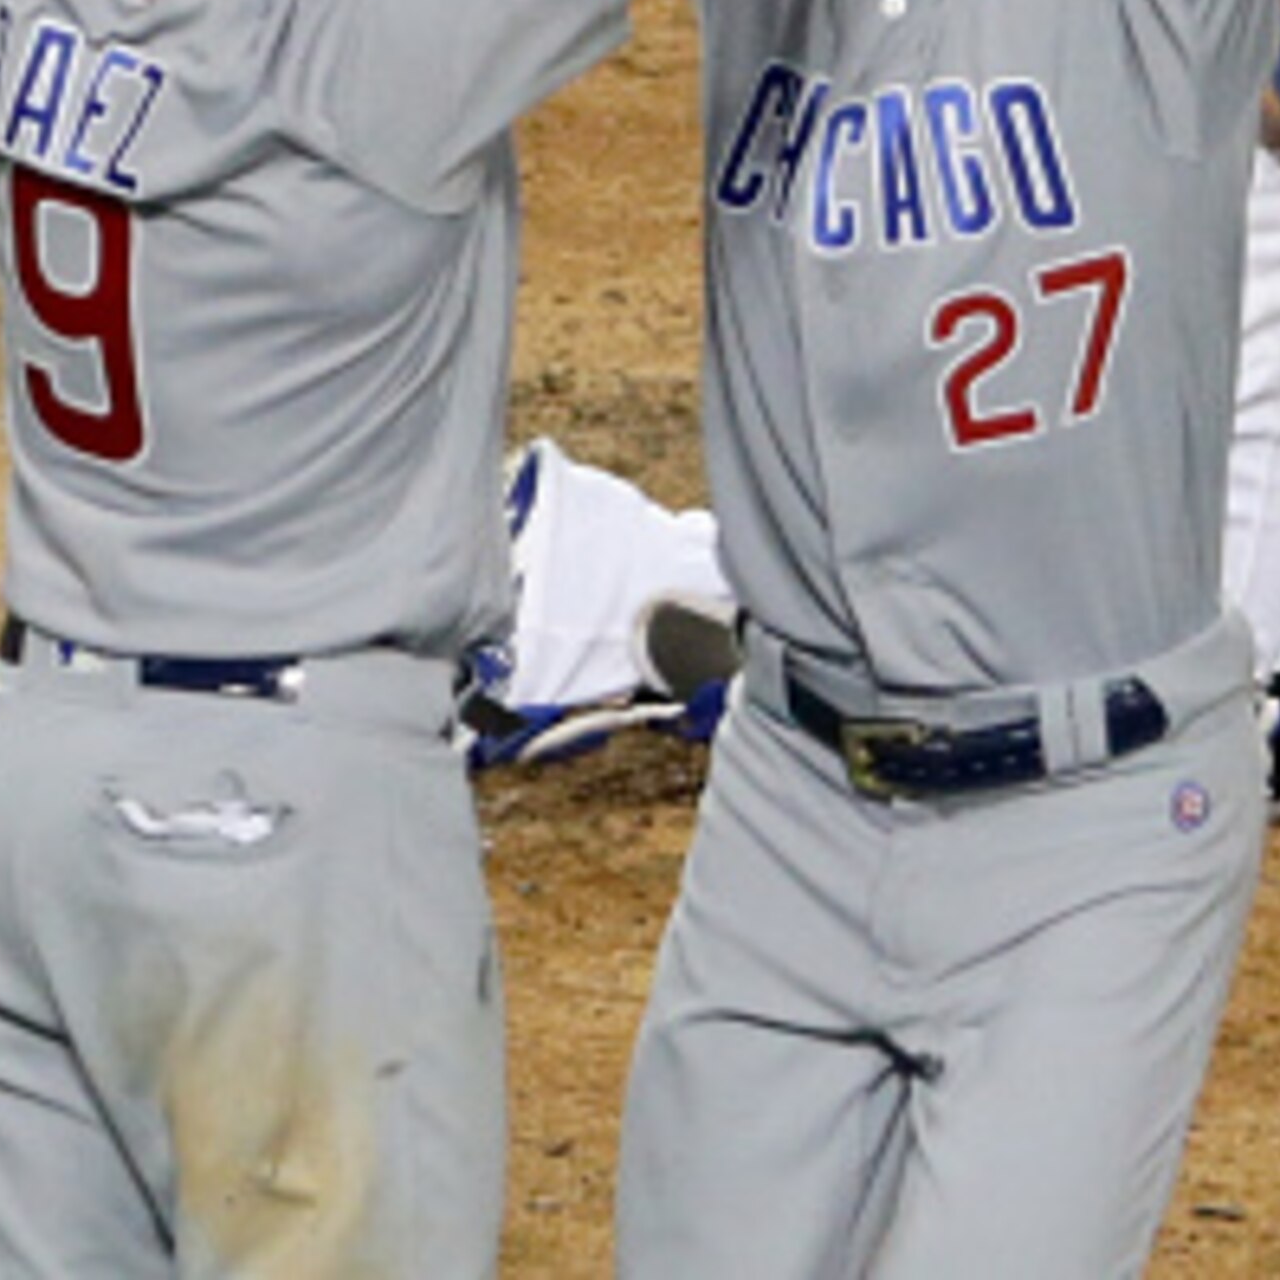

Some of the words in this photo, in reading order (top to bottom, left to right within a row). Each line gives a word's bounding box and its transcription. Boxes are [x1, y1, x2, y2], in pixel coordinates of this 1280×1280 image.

[716, 60, 1076, 248] CHCAGO
[10, 160, 144, 464] 9
[928, 250, 1130, 450] 27
